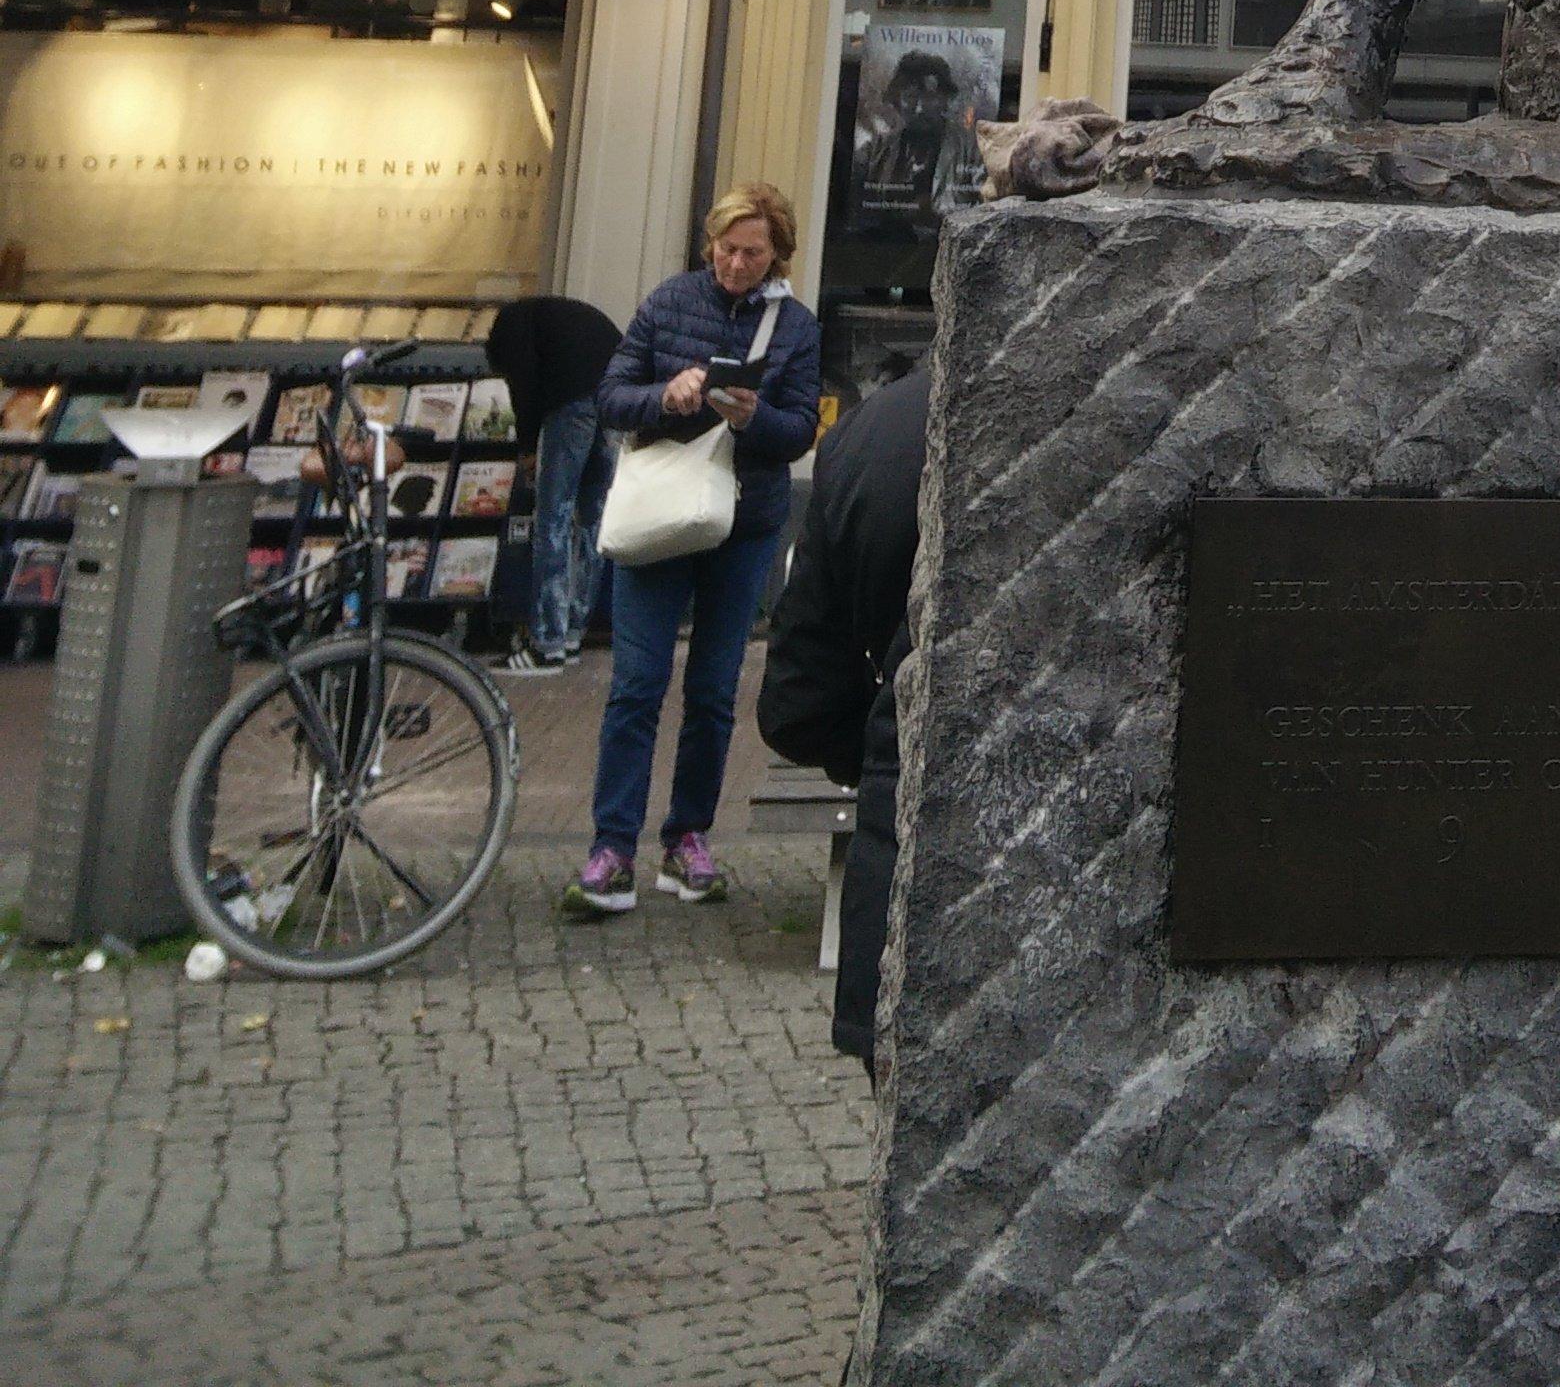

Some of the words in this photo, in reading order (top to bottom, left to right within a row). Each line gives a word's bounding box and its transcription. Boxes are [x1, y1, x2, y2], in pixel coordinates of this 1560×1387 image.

[880, 28, 943, 45] Willem
[946, 29, 994, 47] Kloos
[135, 155, 274, 174] FASHION
[318, 158, 367, 175] THE
[382, 159, 441, 176] NEW
[1264, 705, 1474, 738] GESCHENK
[1260, 759, 1341, 792] VAN
[1359, 759, 1520, 792] HUNTER
